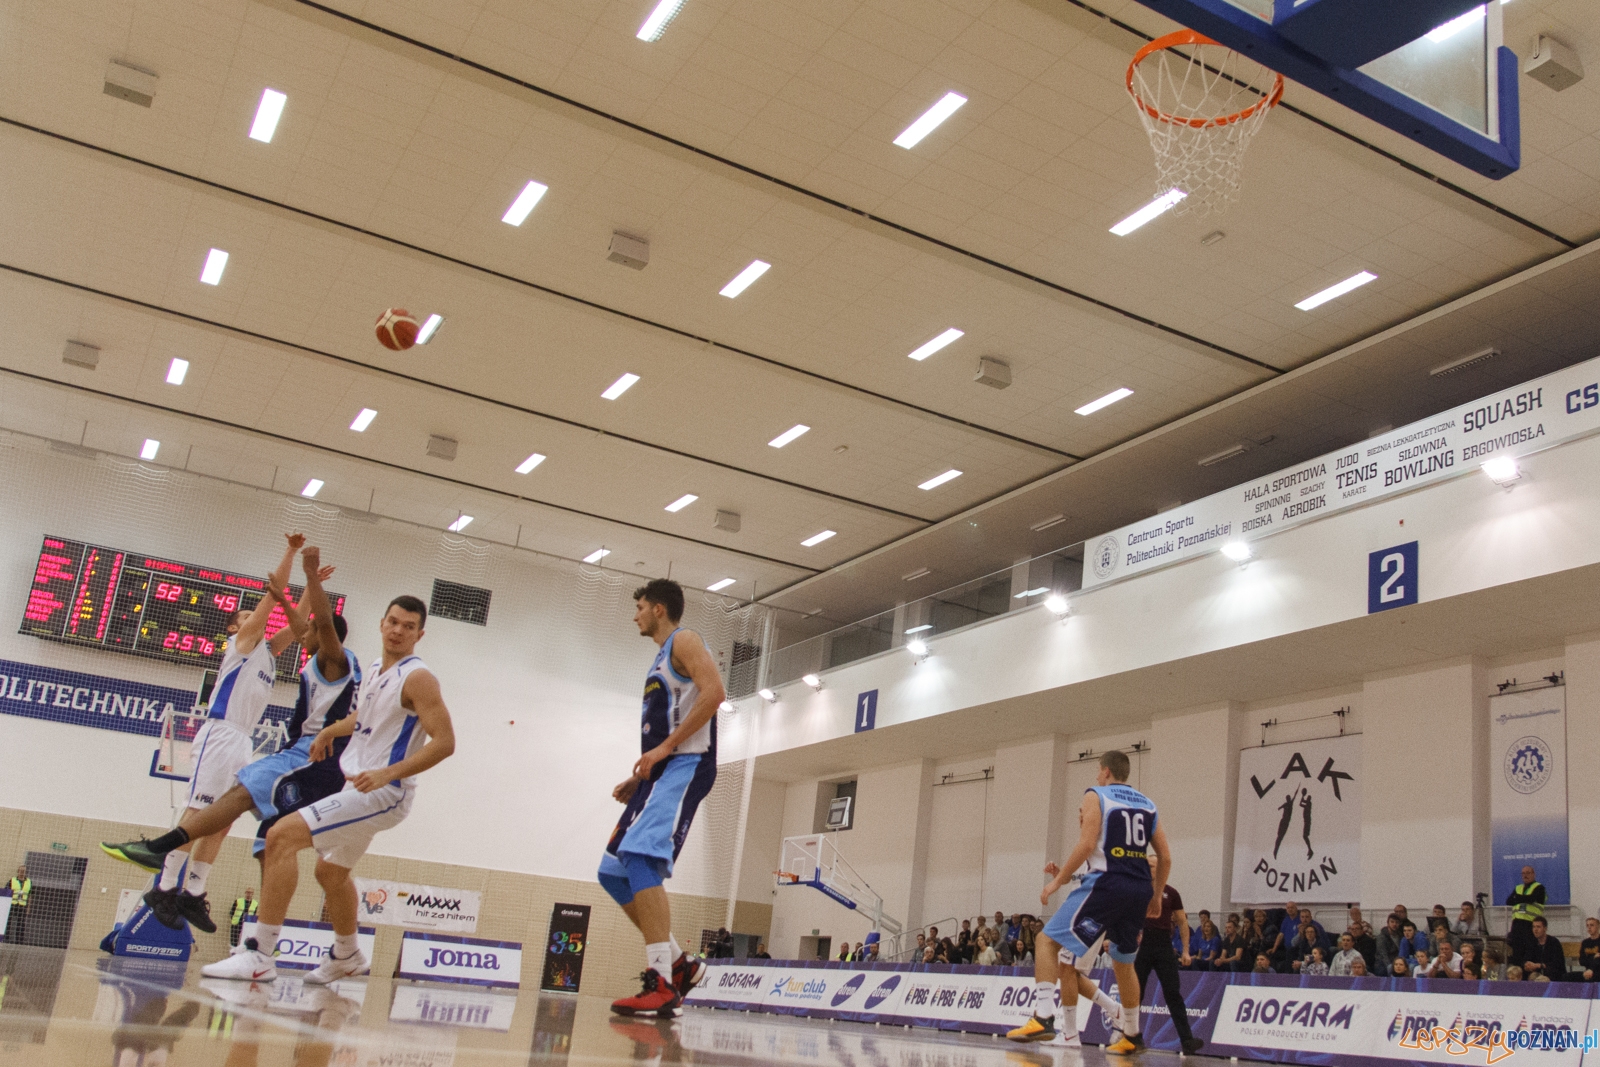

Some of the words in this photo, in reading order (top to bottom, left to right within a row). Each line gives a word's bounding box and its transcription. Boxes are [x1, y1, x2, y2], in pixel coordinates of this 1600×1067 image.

[1463, 387, 1543, 433] SQUASH
[1565, 383, 1600, 414] CS
[1398, 437, 1447, 462] SIŁOWNIA
[1462, 423, 1546, 461] ERGOWIOSŁA
[1335, 452, 1359, 470] JUDO
[1384, 450, 1454, 487] BOWLING
[1244, 484, 1270, 502] HALA
[1272, 463, 1327, 493] SPORTOWA
[1336, 462, 1378, 489] TENIS
[1300, 481, 1326, 497] SZACHY
[1342, 485, 1367, 499] KARATE
[1282, 494, 1326, 520] AEROBIK
[1127, 527, 1163, 546] Centrum
[1166, 516, 1194, 535] Sportu
[1242, 514, 1273, 533] BOISKA
[1126, 541, 1174, 566] Politechniki
[1178, 521, 1232, 549] Poznańskiej
[1380, 552, 1406, 604] 2
[155, 582, 184, 602] 52
[213, 593, 238, 613] 45
[860, 695, 869, 728] 1
[1250, 752, 1355, 802] LAK
[319, 799, 342, 814] 1
[1121, 810, 1146, 847] 16
[1253, 856, 1338, 893] POZNAŃ
[406, 894, 462, 912] MAXXX
[131, 907, 154, 934] HYDROPL
[431, 911, 445, 919] za
[549, 931, 583, 954] 35
[424, 948, 500, 970] Joma
[718, 972, 763, 989] BIOFARM
[787, 977, 827, 993] funclub
[911, 988, 930, 1005] PBG
[937, 989, 957, 1007] PBG
[964, 991, 985, 1009] PBG
[999, 986, 1063, 1008] BIOFR
[1235, 998, 1355, 1029] BIOFARM
[1406, 1008, 1441, 1017] fundacja
[1466, 1011, 1504, 1020] fundacja
[1532, 1014, 1573, 1024] fundacja
[1240, 1027, 1264, 1036] POLSKI
[1267, 1029, 1308, 1039] PRODUCENT
